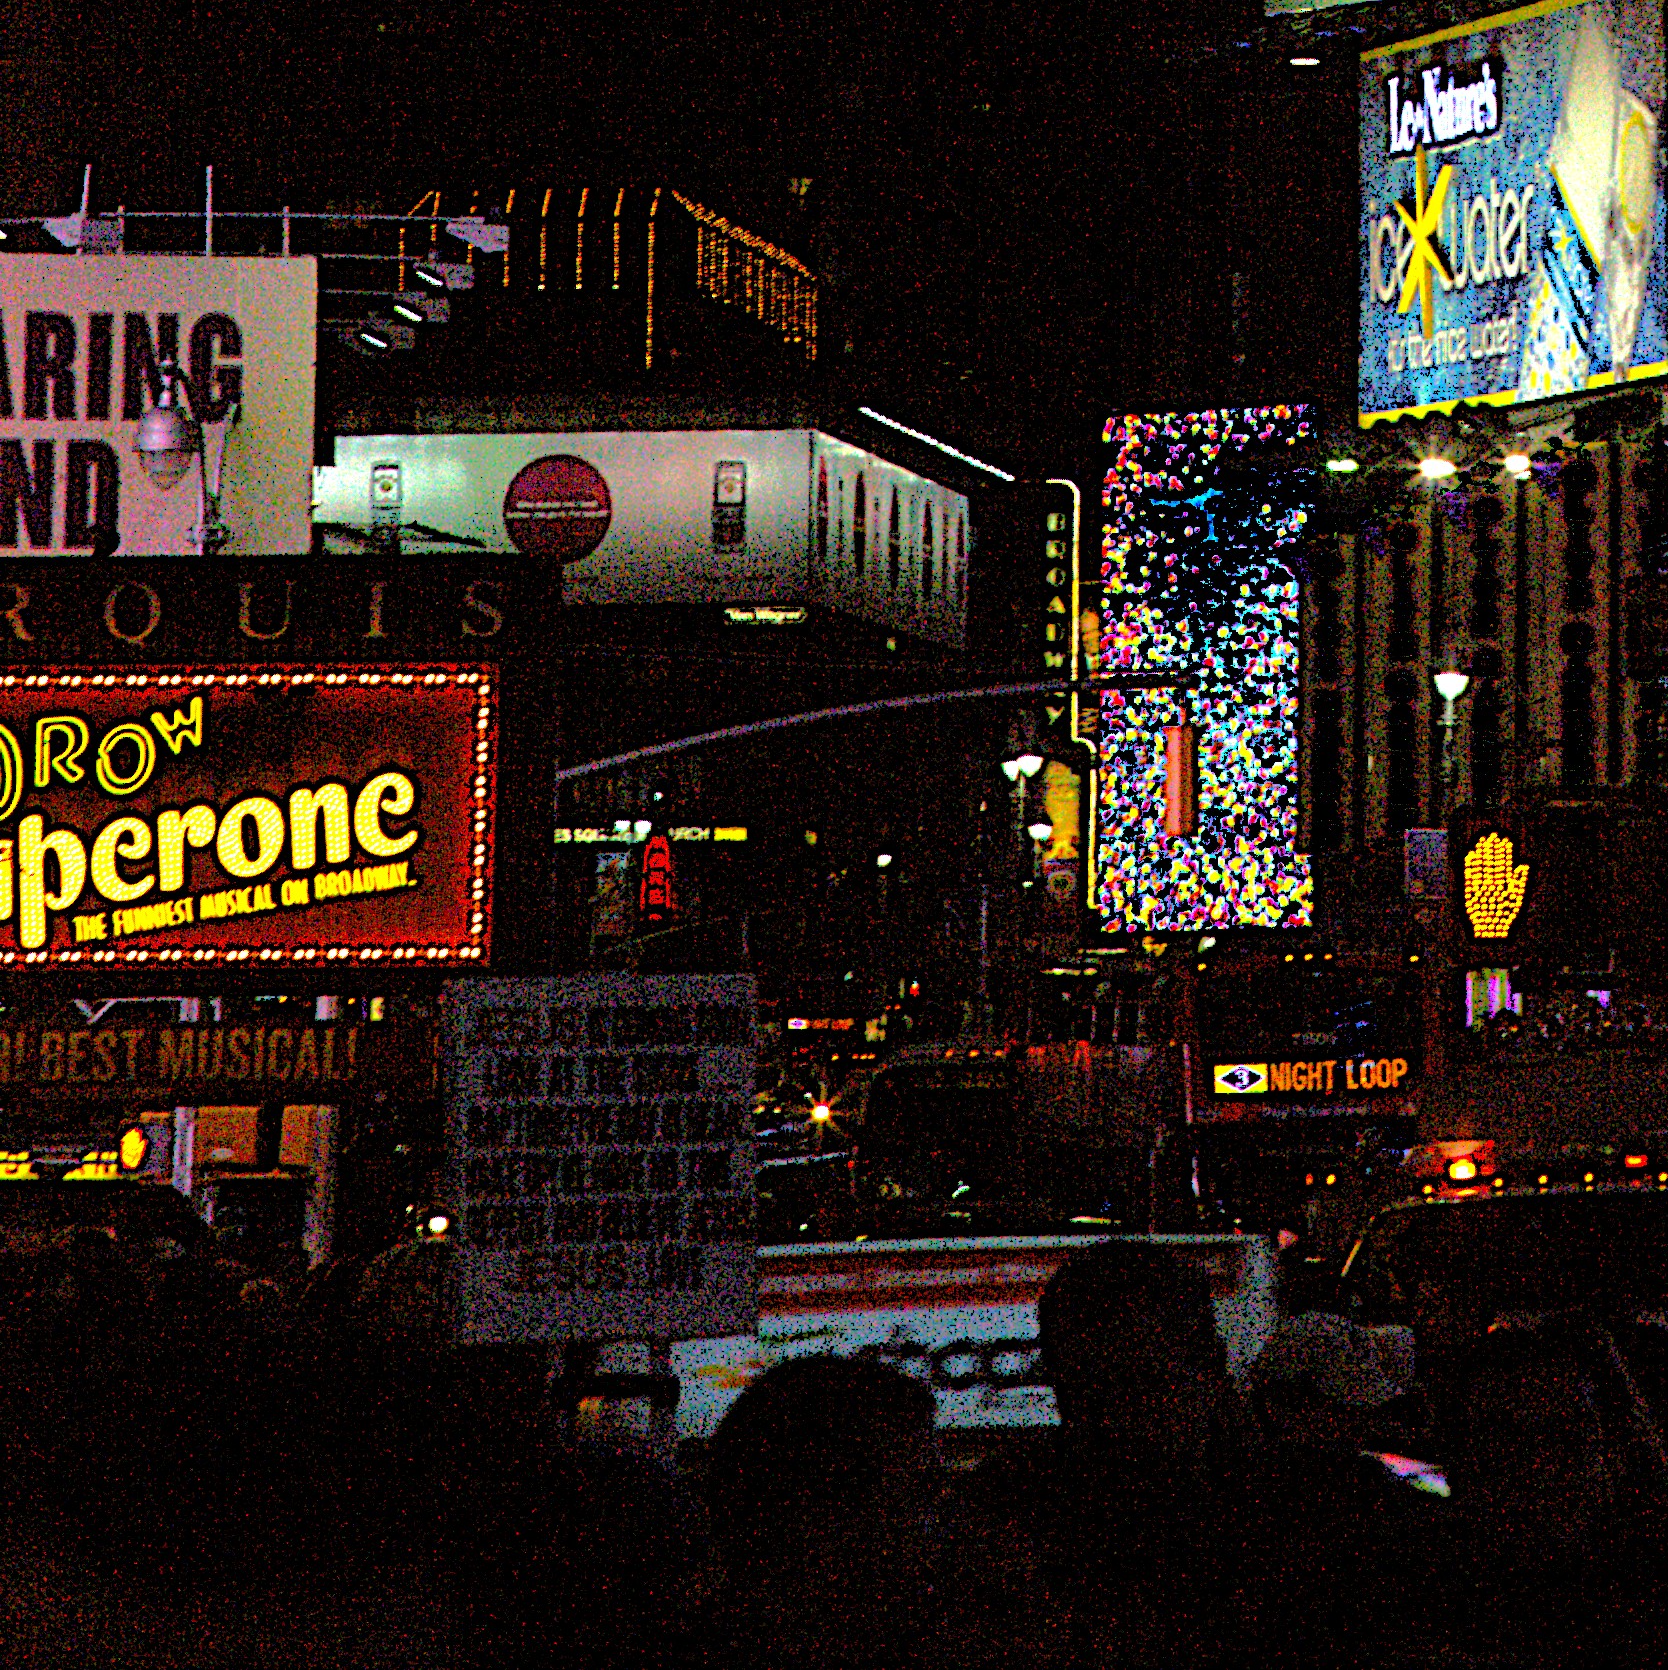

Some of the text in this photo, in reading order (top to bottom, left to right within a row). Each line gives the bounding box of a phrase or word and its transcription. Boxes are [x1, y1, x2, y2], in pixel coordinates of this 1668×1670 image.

[72, 912, 108, 943] THE
[112, 897, 196, 938] FUNNIEST
[199, 883, 277, 921] MUSICAL
[281, 878, 309, 907] ON
[40, 1027, 145, 1082] BEST
[1270, 1060, 1337, 1092] NIGHT
[1346, 1057, 1408, 1090] LOOP
